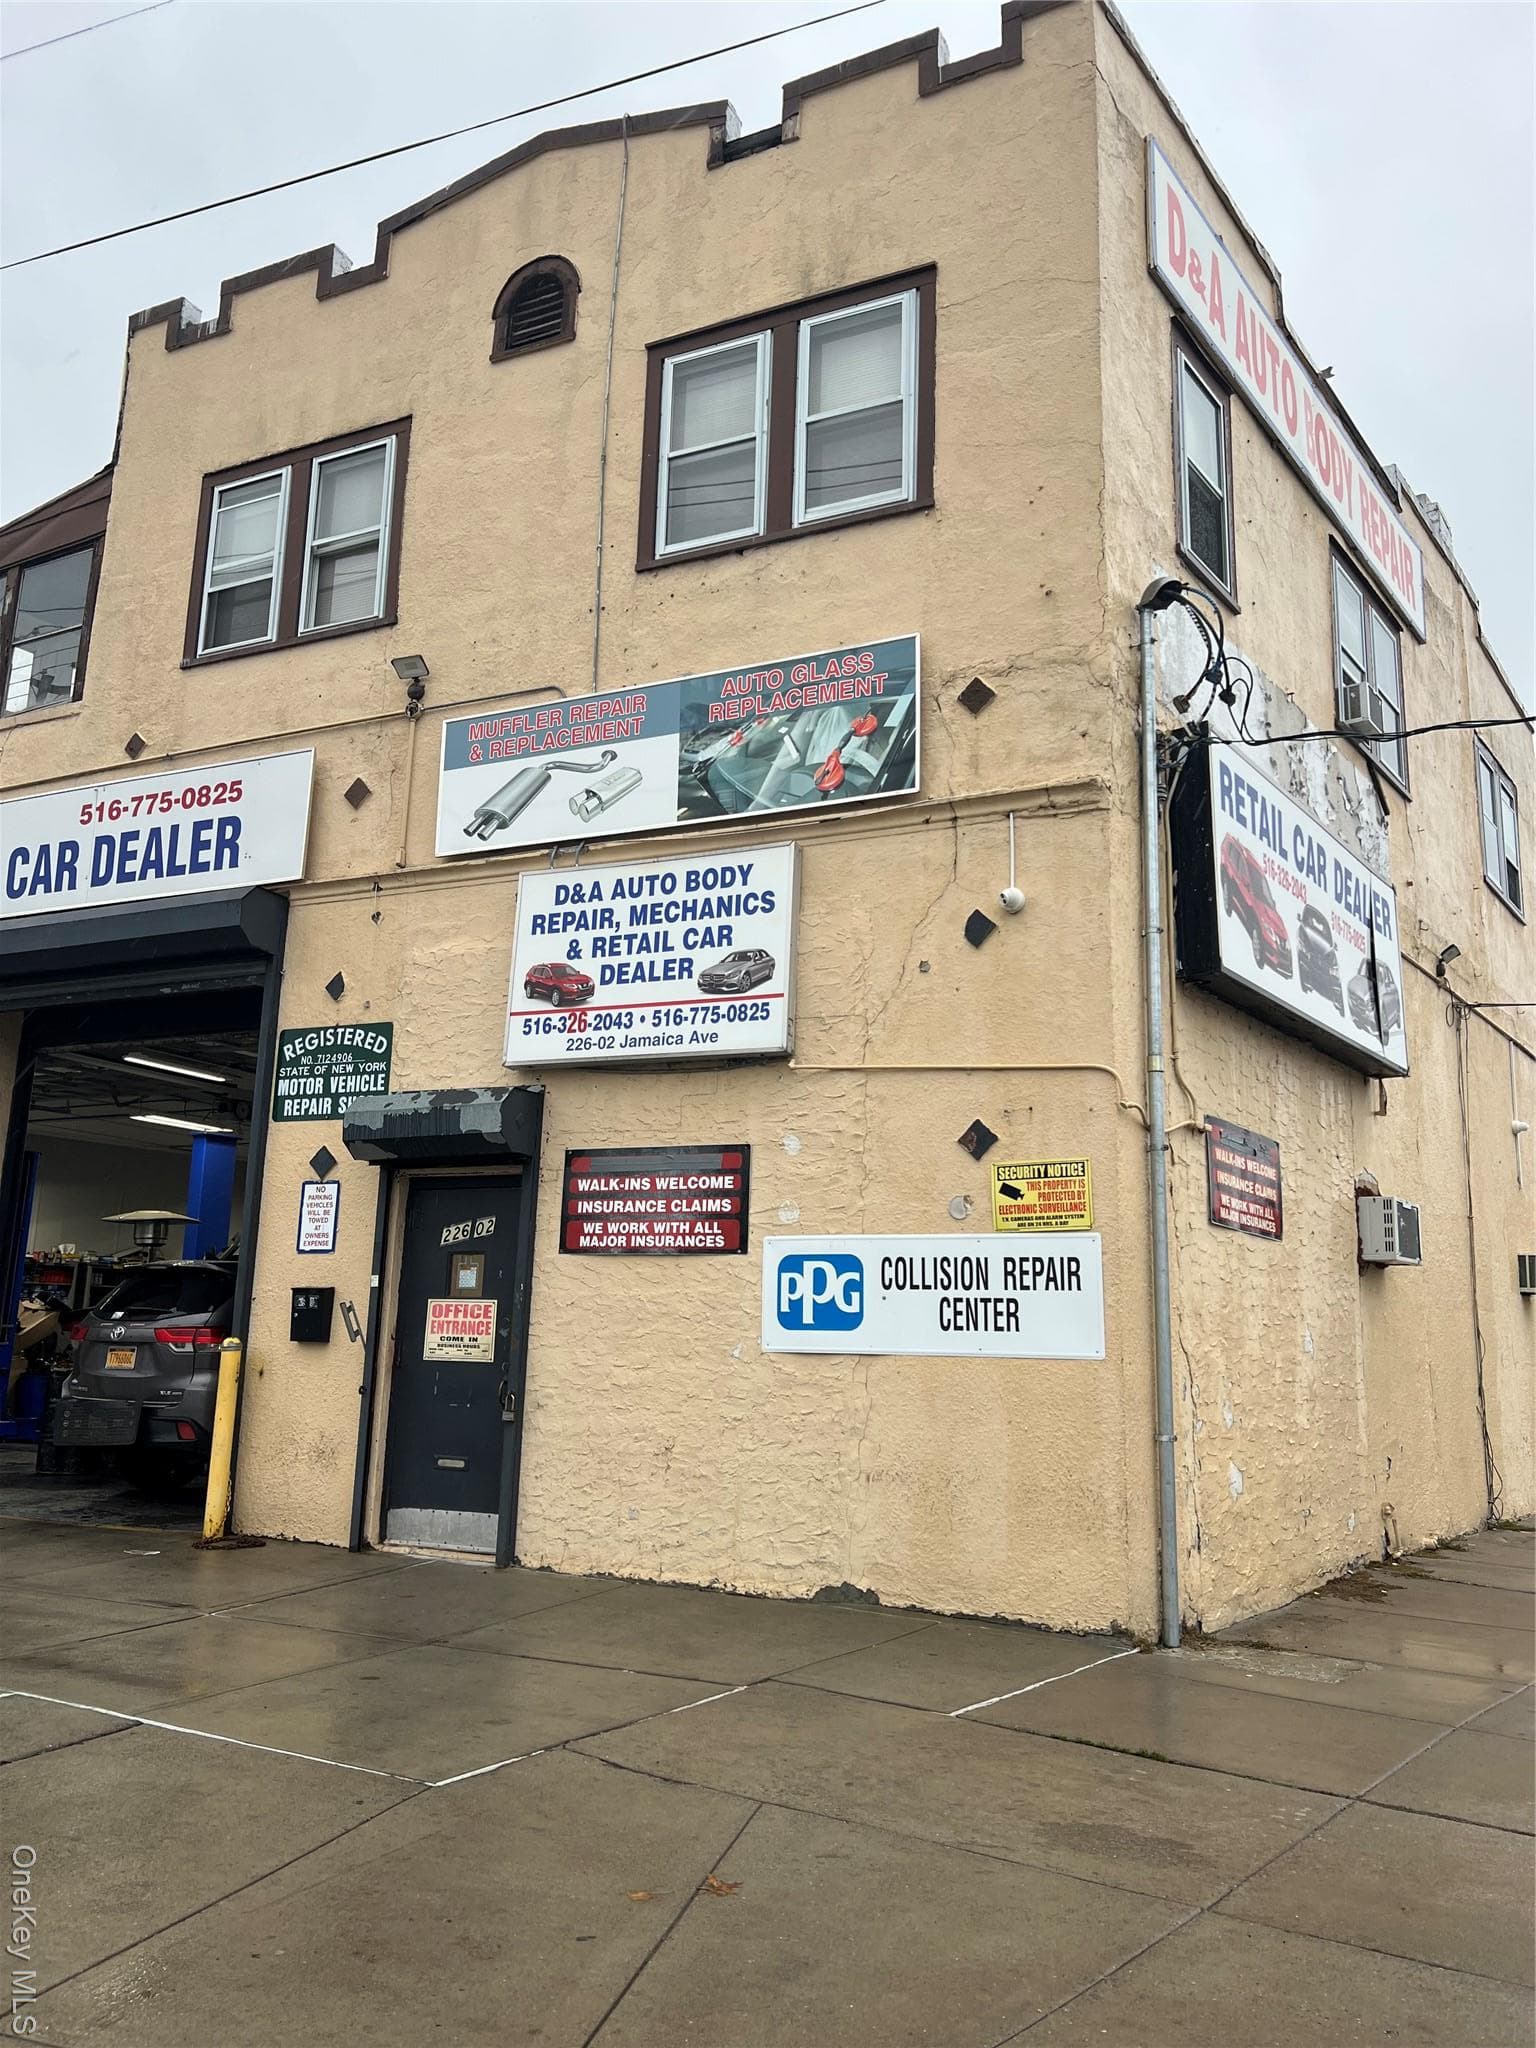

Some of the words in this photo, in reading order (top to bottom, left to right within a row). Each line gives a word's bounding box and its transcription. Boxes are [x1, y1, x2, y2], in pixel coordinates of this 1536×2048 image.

[1167, 181, 1227, 344] D&A
[1236, 288, 1297, 439] AUTO
[1303, 386, 1353, 520] BODY
[1359, 472, 1417, 612] REPAIR
[721, 669, 784, 698] AUTO
[791, 652, 874, 686] GLASS
[708, 673, 888, 723] REPLACEMENT
[468, 709, 562, 741] MUFFLER
[570, 694, 647, 726] REPAIR
[468, 745, 483, 762] &
[489, 716, 645, 759] REPLACEMENT
[80, 780, 242, 825] 516-775-0825
[6, 840, 79, 899] CAR
[91, 816, 242, 888] DEALER
[1219, 760, 1288, 862] RETAIL
[1292, 824, 1328, 893] CAR
[1334, 857, 1392, 941] DEALER
[554, 881, 602, 906] D&A
[611, 872, 677, 900] AUTO
[686, 864, 754, 892] BODY
[1263, 853, 1307, 904] 516-326-2043
[531, 908, 621, 935] REPAIR,
[629, 890, 776, 926] MECHANICS
[566, 939, 582, 960] &
[592, 931, 674, 958] RETAIL
[682, 924, 733, 950] CAR
[600, 958, 694, 986] DEALER
[522, 1011, 634, 1036] 516-326-2043
[652, 1002, 770, 1028] 516-775-0825
[283, 1028, 387, 1061] REGISTERED
[566, 1037, 614, 1051] 226-02
[620, 1034, 683, 1050] Jamaica
[689, 1030, 718, 1044] Ave
[280, 1066, 310, 1076] STATE
[314, 1066, 327, 1075] OF
[332, 1064, 354, 1074] NEW
[359, 1062, 386, 1072] YORK
[301, 1056, 313, 1065] NO.
[278, 1078, 323, 1096] MOTOR
[330, 1074, 385, 1093] VEHICLE
[284, 1098, 332, 1116] REPAIR
[999, 1165, 1045, 1180] SECURITY
[1047, 1163, 1084, 1177] NOTICE
[1215, 1147, 1245, 1169] WALK-INS
[1247, 1159, 1277, 1180] WELCOME
[578, 1178, 650, 1192] WALK-INS
[656, 1176, 734, 1190] WELCOME
[1026, 1182, 1041, 1191] THIS
[1043, 1180, 1076, 1190] PROPERTY
[1079, 1179, 1085, 1189] IS
[1038, 1191, 1076, 1202] PROTECTED
[1077, 1191, 1086, 1200] BY
[1217, 1170, 1254, 1194] INSURANCE
[1255, 1182, 1277, 1202] CLAIMS
[578, 1200, 666, 1214] INSURANCE
[671, 1199, 731, 1212] CLAIMS
[999, 1204, 1038, 1215] ELECTRONIC
[1039, 1202, 1086, 1213] SURVEILLANCE
[1221, 1194, 1230, 1206] WE
[1231, 1197, 1248, 1212] WORK
[1249, 1202, 1264, 1215] WITH
[1265, 1208, 1274, 1220] ALL
[443, 1224, 470, 1242] 226
[476, 1220, 494, 1236] 02
[584, 1223, 603, 1234] WE
[608, 1223, 648, 1234] WORK
[654, 1222, 689, 1233] WITH
[694, 1222, 721, 1233] ALL
[1240, 1214, 1276, 1232] INSURANCES
[580, 1236, 626, 1247] MAJOR
[631, 1235, 725, 1247] INSURANCES
[781, 1261, 860, 1324] PPG
[881, 1256, 989, 1291] COLLISION
[1004, 1256, 1082, 1291] REPAIR
[432, 1304, 492, 1319] OFFICE
[939, 1296, 1020, 1332] CENTER
[431, 1320, 491, 1335] ENTRANCE
